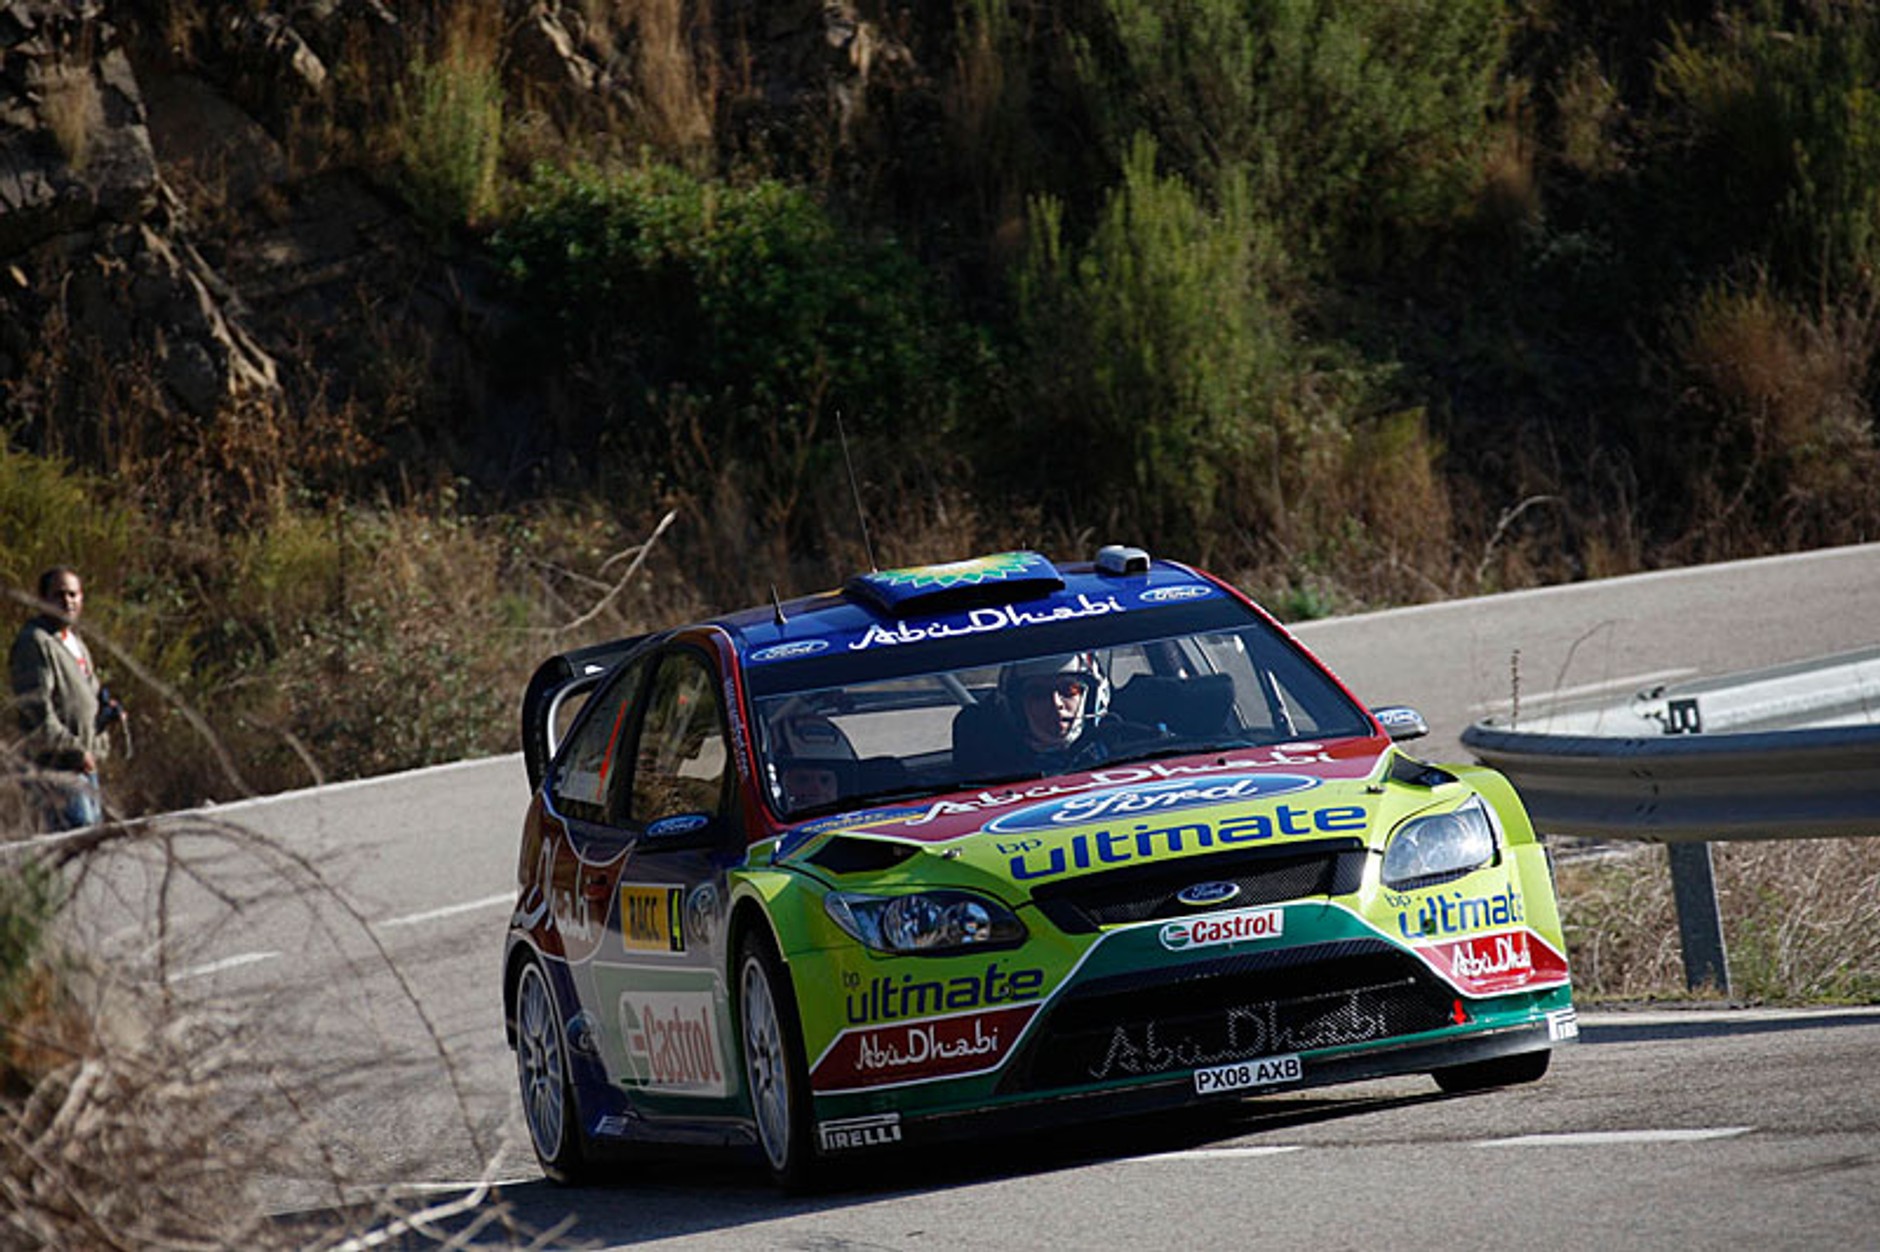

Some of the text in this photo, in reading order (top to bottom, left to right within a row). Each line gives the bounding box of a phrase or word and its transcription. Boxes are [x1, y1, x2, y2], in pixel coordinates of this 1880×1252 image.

[1153, 585, 1204, 601] Ford
[764, 643, 813, 660] Ford
[1051, 779, 1259, 823] Ford
[996, 838, 1042, 855] bp
[1009, 805, 1367, 880] ultimate
[1191, 912, 1275, 944] Castrol
[846, 963, 1044, 1024] ultimate
[643, 1003, 721, 1083] Castrol
[1197, 1059, 1298, 1090] PX08 AXB
[818, 1112, 902, 1150] PIRELLI
